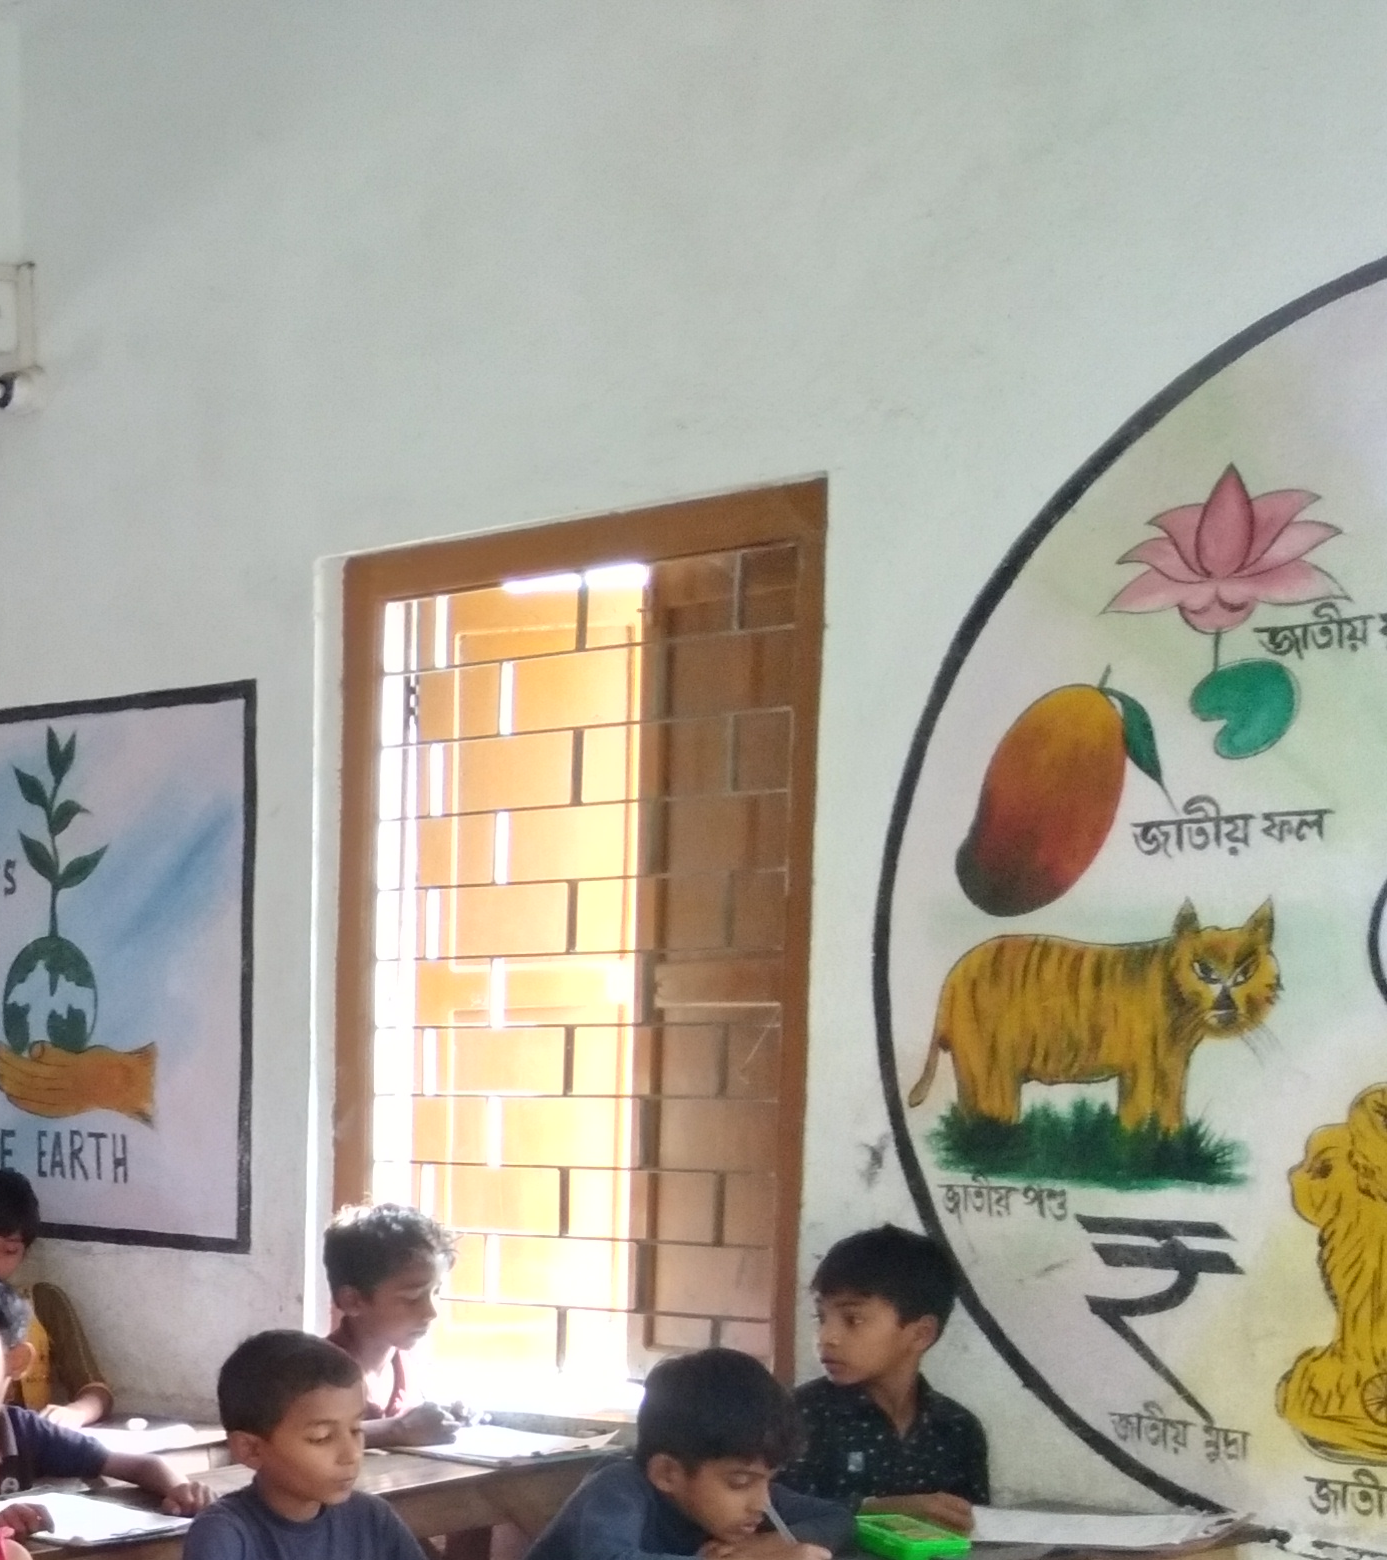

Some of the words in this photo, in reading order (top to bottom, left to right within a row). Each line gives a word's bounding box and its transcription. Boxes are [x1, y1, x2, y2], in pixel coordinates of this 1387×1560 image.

[1253, 602, 1375, 660] জাতীয়
[1132, 795, 1252, 857] জাতীয়
[1261, 808, 1335, 842] ফল
[36, 1129, 128, 1183] EARTH
[937, 1173, 1020, 1224] জাতীয়
[1108, 1400, 1197, 1454] জাতীয়
[1304, 1468, 1387, 1518] জাতী
